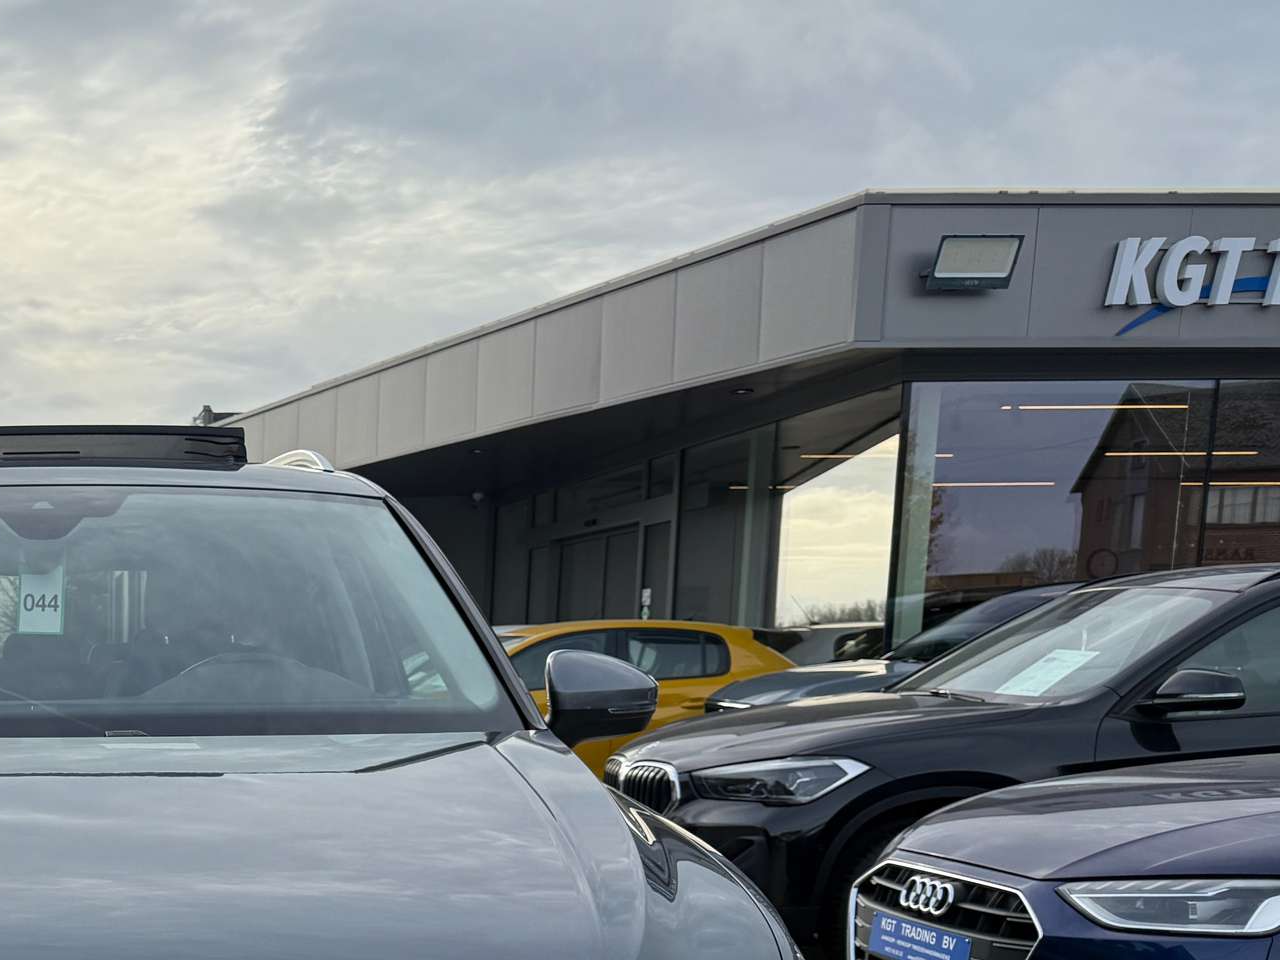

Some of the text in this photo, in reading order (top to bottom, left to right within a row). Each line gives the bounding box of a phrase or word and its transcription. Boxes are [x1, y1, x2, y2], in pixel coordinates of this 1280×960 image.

[1104, 235, 1257, 307] KGT
[23, 593, 60, 612] 044
[881, 917, 896, 932] KGT
[901, 923, 936, 944] TRADING
[942, 936, 956, 950] BV
